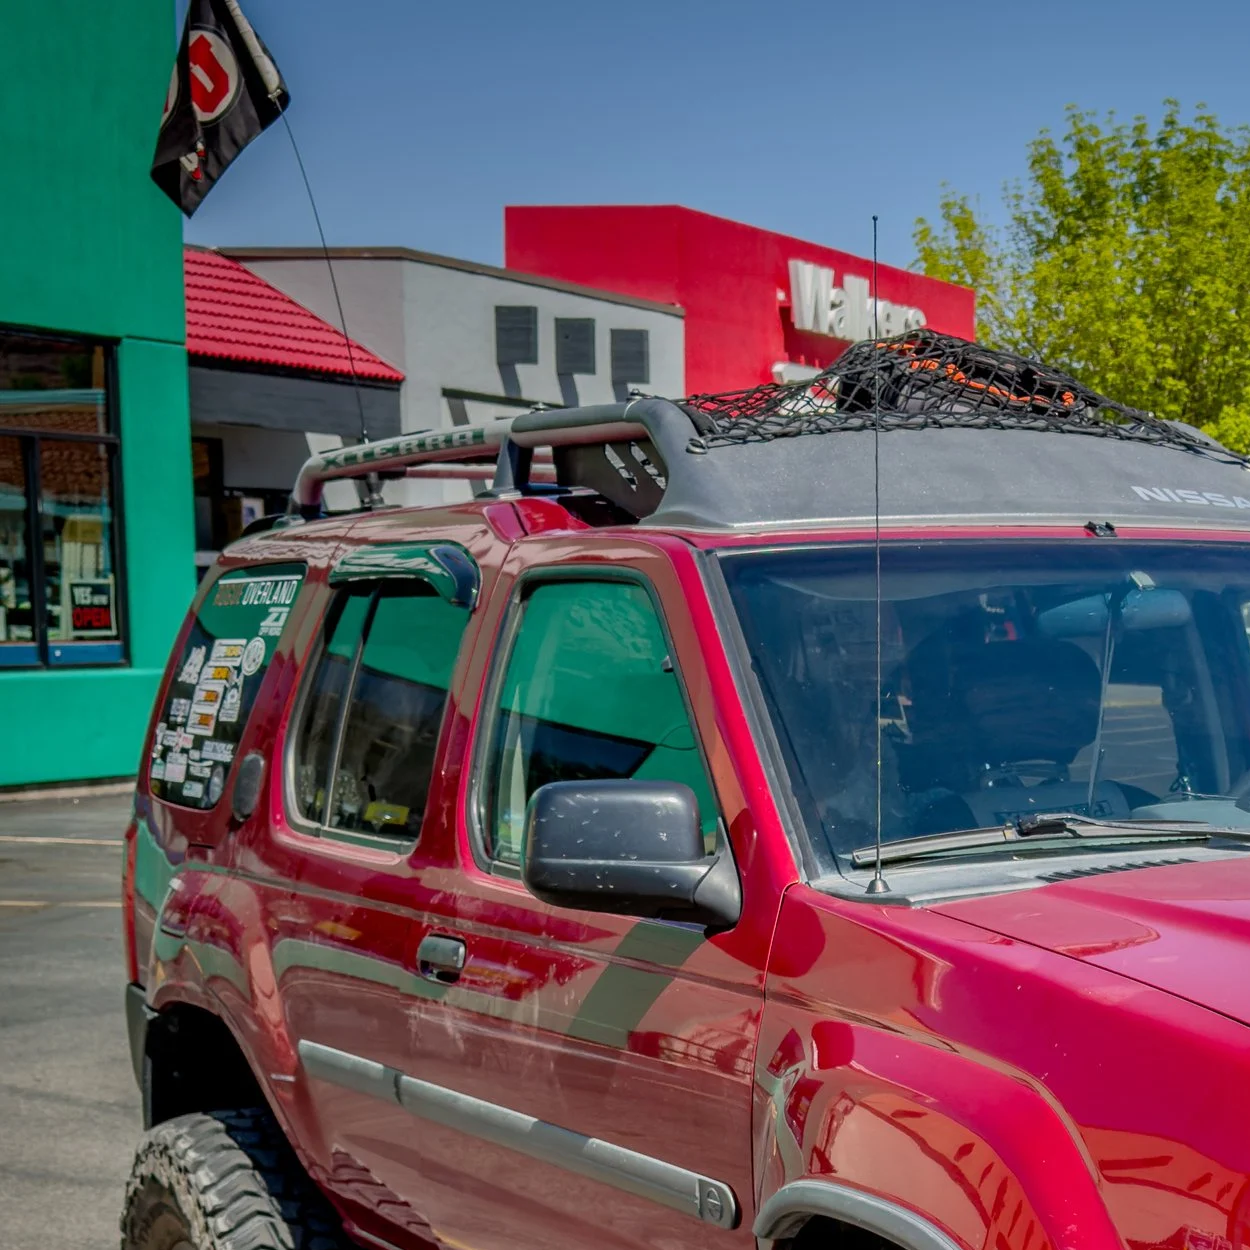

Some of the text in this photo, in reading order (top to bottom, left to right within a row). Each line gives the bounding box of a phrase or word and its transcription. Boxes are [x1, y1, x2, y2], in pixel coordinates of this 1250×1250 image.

[321, 428, 486, 471] XTERRA
[242, 580, 298, 605] OVERLAND
[72, 607, 111, 628] OPEN
